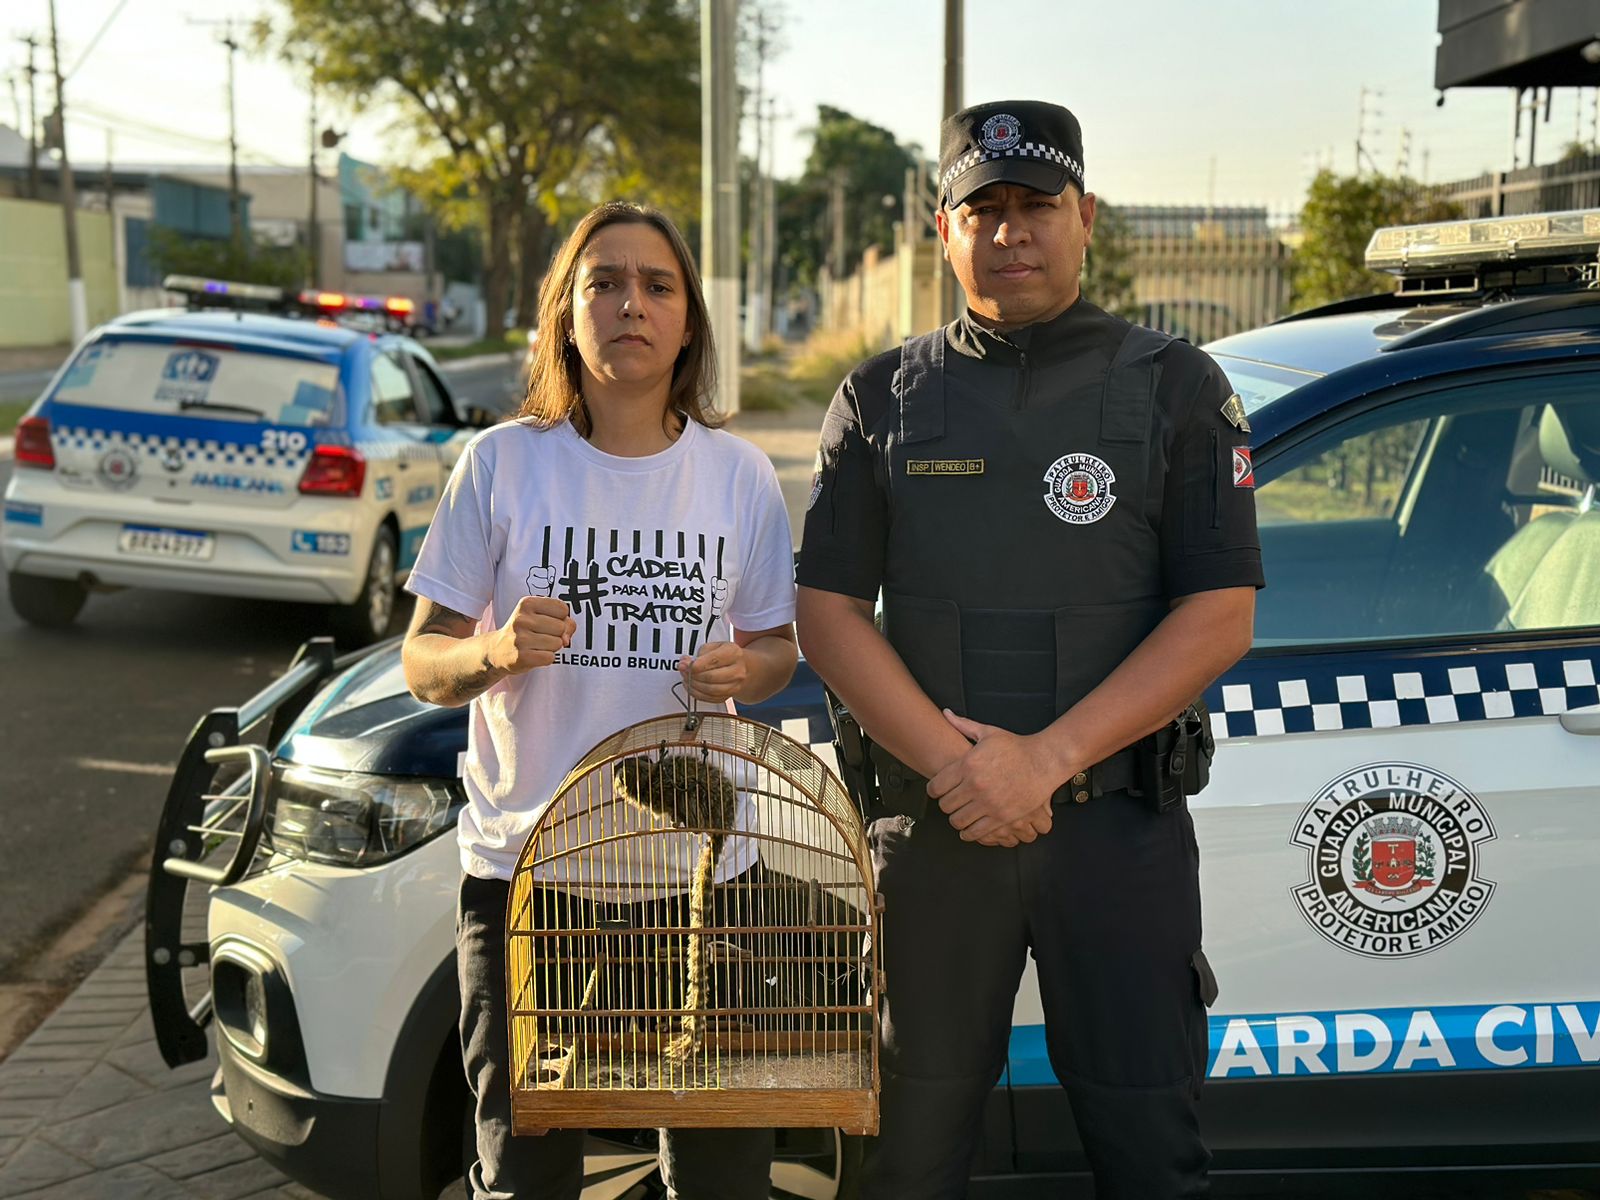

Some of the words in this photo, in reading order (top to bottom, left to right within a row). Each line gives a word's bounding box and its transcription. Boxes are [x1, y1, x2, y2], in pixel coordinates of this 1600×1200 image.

[261, 428, 307, 451] 210
[1049, 455, 1112, 479] PATRULHEIRO
[1054, 466, 1074, 493] GUARDA
[1078, 464, 1106, 494] MUNICIPAL
[1048, 496, 1083, 522] PROTETOR
[1091, 497, 1112, 519] AMIGO
[1057, 496, 1103, 514] AMERICANA
[606, 555, 705, 585] CADEIA
[612, 584, 648, 597] PARA
[652, 582, 705, 603] MAUS
[604, 602, 703, 626] TRATOS
[553, 653, 622, 668] ELEGADO
[1302, 768, 1484, 840] PATRULHEIRO
[1320, 799, 1375, 878] GUARDA
[1388, 791, 1467, 875] MUNICIPAL
[1301, 887, 1403, 953] PROTETOR
[1408, 933, 1423, 950] E
[1427, 885, 1485, 945] AMIGO
[1327, 887, 1460, 933] AMERICANA
[1208, 1010, 1457, 1078] ARDA
[1474, 1004, 1600, 1067] CIV
